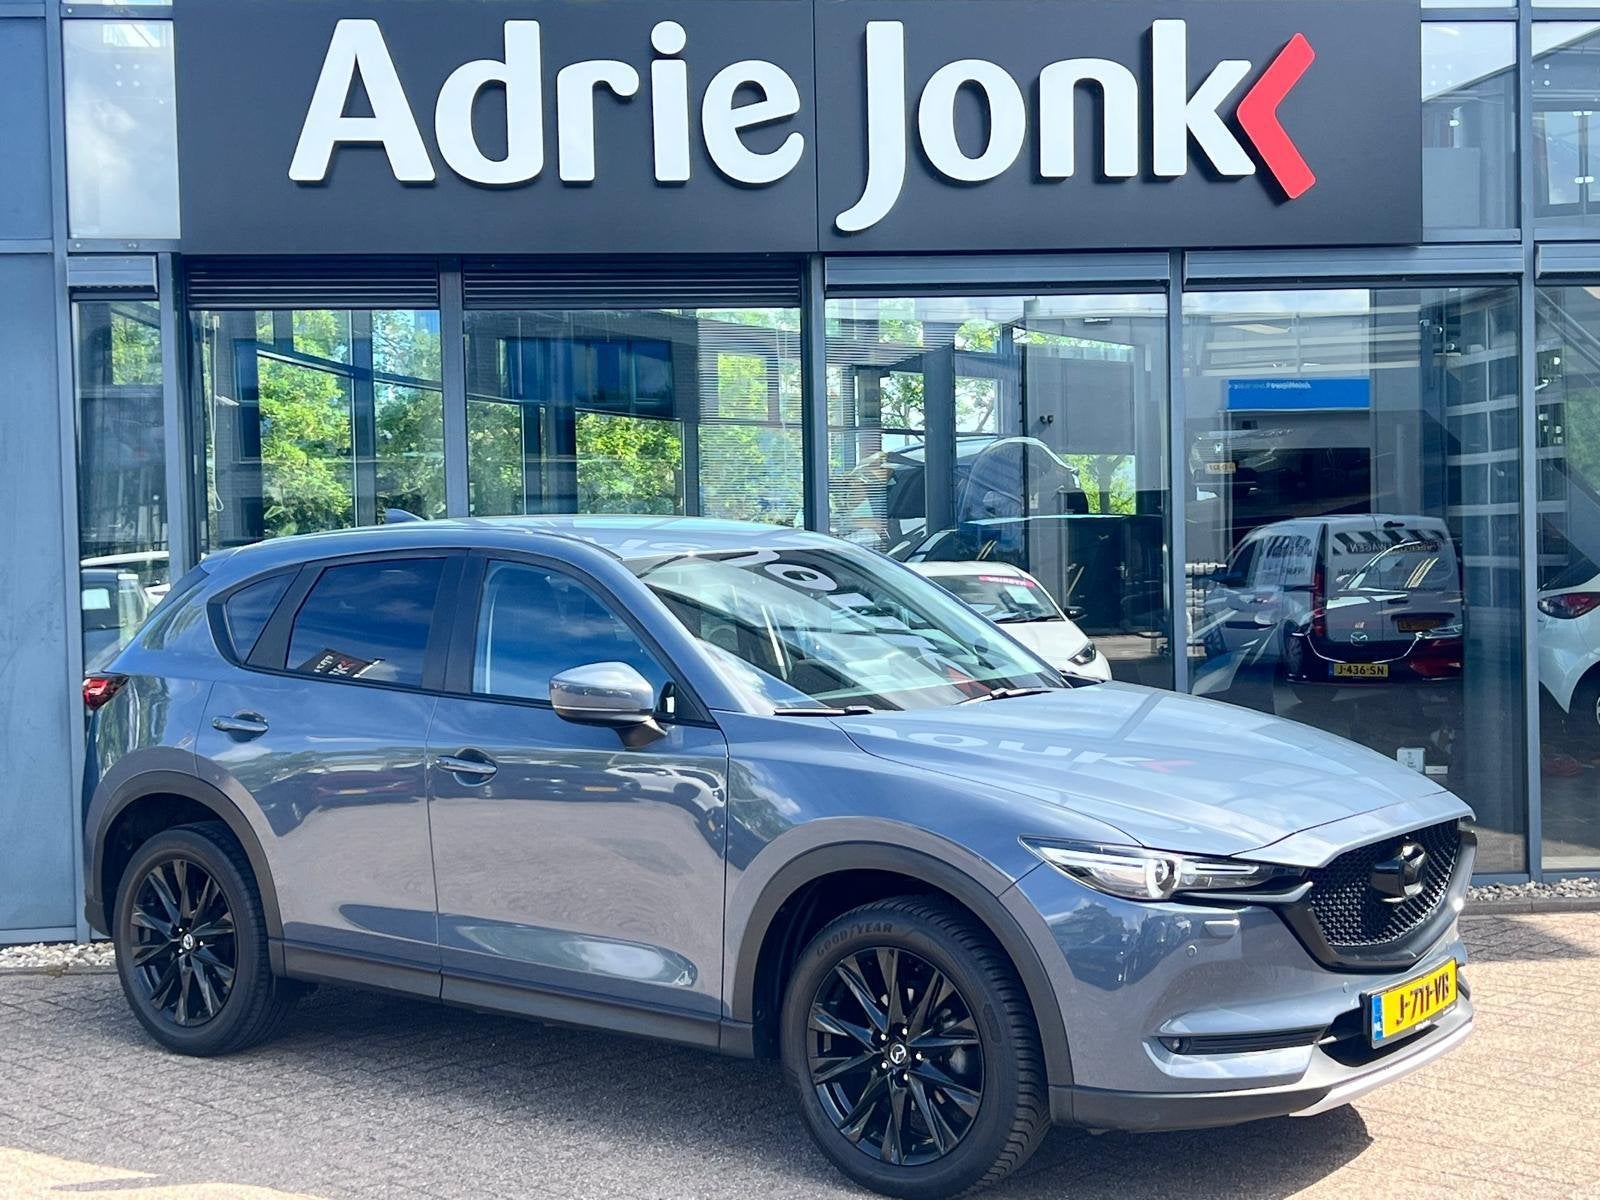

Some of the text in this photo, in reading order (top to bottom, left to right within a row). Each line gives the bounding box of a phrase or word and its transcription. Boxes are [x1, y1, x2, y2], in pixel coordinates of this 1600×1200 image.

[288, 19, 1255, 232] Adrie Jonk
[1338, 665, 1385, 675] J-436-SN
